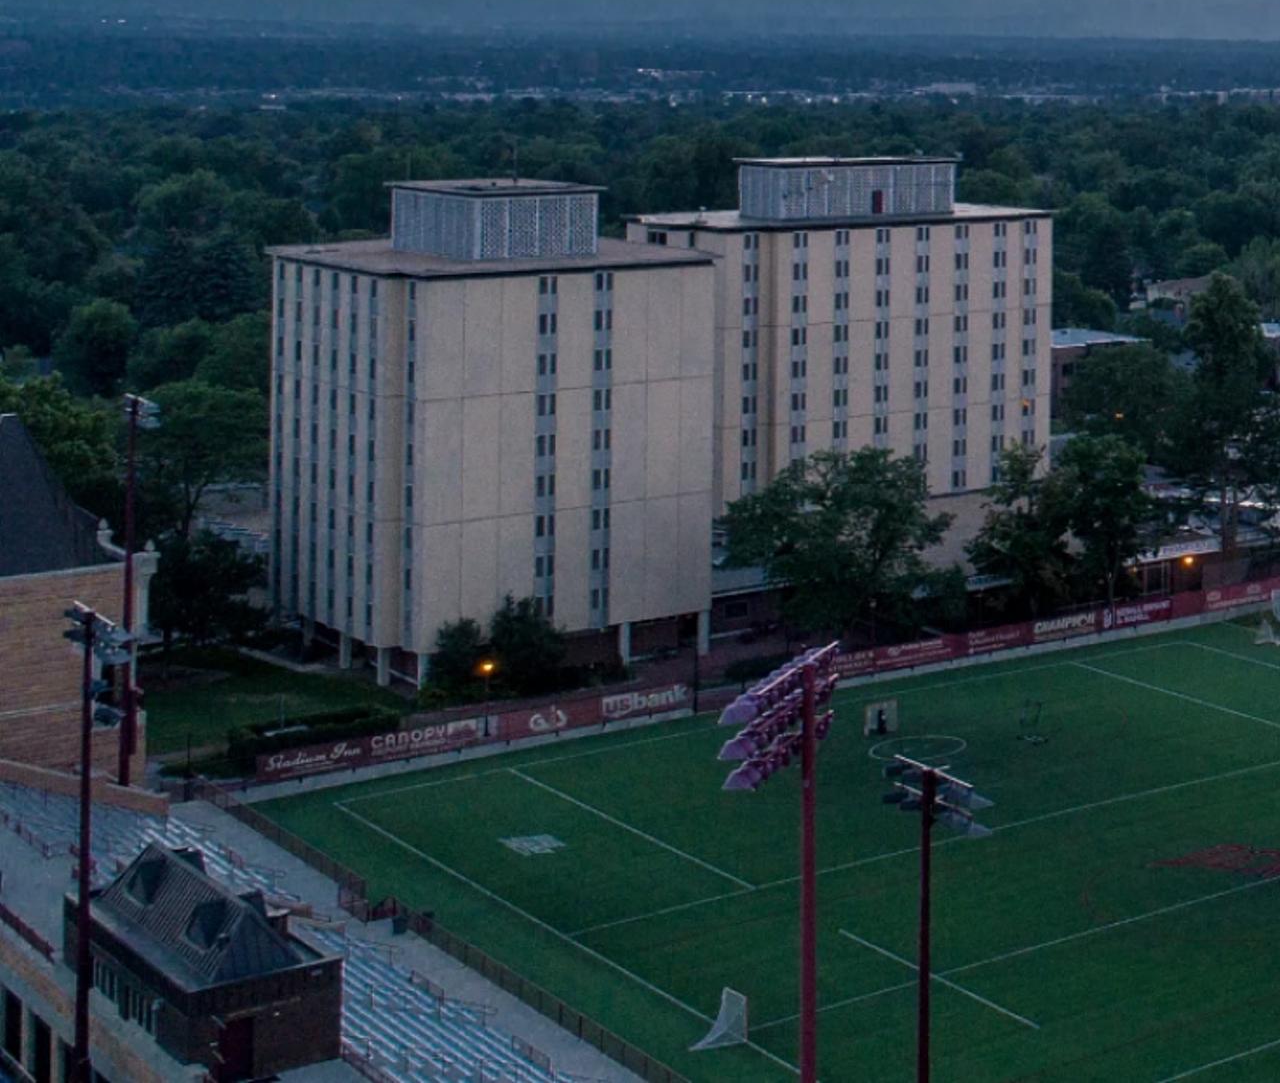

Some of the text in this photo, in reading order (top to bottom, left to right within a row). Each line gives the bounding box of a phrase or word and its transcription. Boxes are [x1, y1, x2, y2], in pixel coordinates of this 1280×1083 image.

[371, 723, 445, 749] CANOPY
[264, 751, 326, 771] Stadium
[329, 742, 361, 760] Inn
